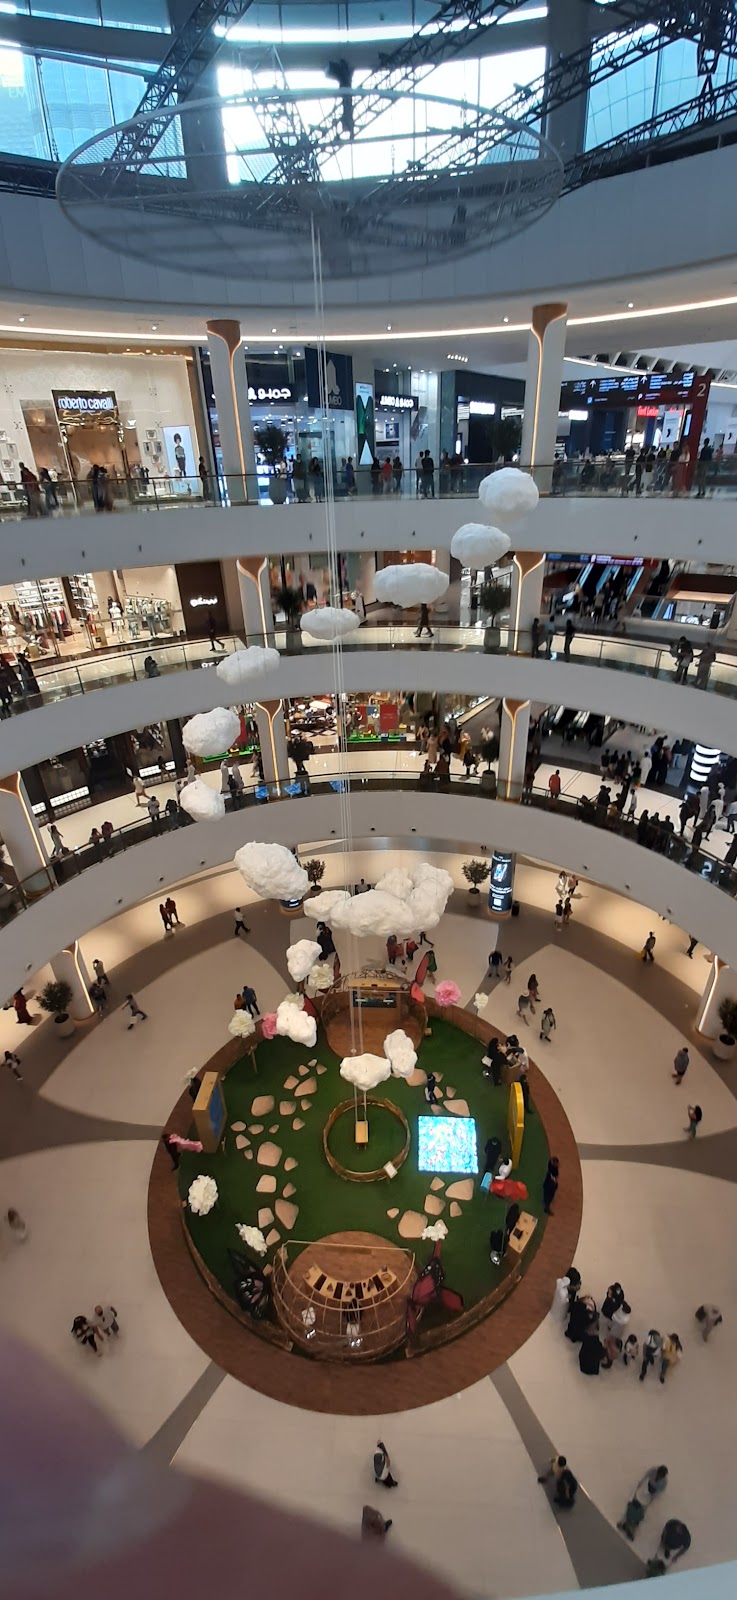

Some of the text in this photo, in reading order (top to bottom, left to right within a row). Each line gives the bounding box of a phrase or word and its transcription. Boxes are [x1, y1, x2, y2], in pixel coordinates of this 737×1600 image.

[697, 383, 706, 397] 2
[58, 396, 114, 410] roberto cavalli
